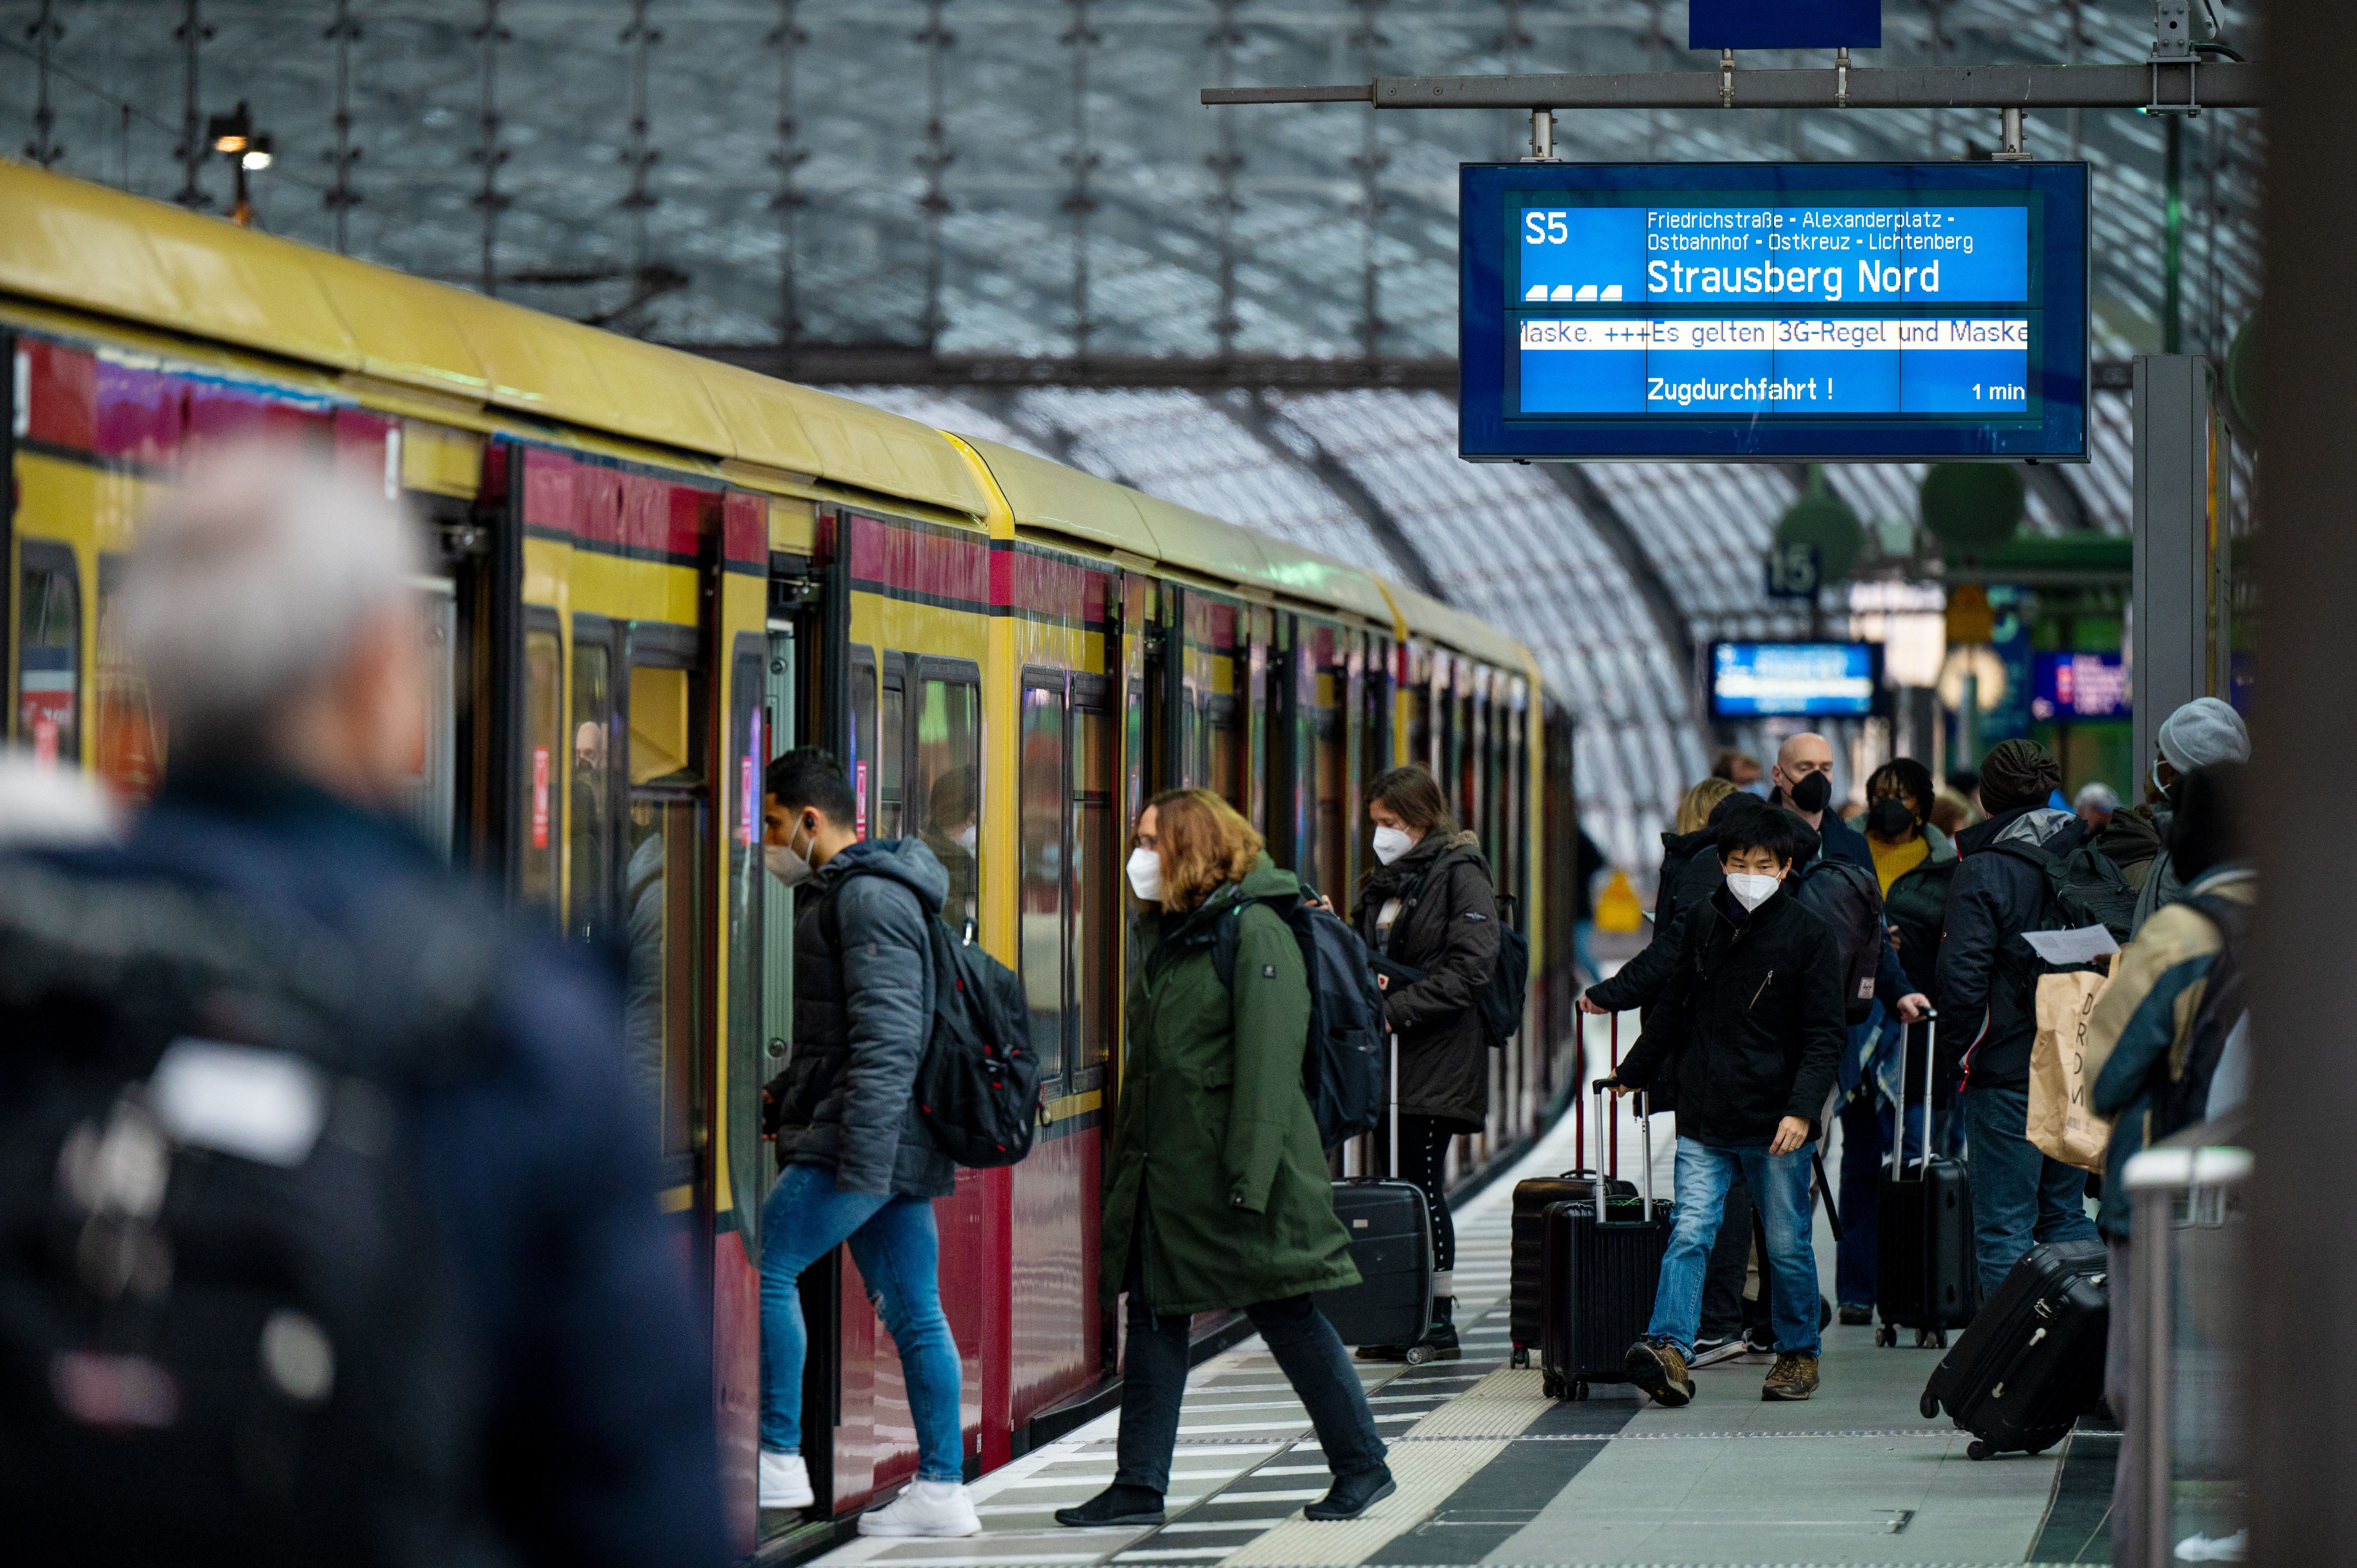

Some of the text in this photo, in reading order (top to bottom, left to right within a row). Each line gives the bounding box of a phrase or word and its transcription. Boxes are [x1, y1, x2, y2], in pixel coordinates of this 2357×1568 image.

[1526, 212, 1568, 244] S5
[1648, 211, 1783, 229] Friedrichstraße
[1803, 211, 1941, 232] Alexanderplatz
[1648, 234, 1749, 250] Ostbahnhof
[1769, 234, 1850, 250] Ostkreuz
[1869, 233, 1973, 254] Lichtenberg
[1648, 260, 1939, 301] Strausberg Nord
[1691, 321, 1765, 348] gelten
[1777, 321, 1886, 348] 3G-Regel
[1899, 321, 1938, 342] und
[1951, 321, 2027, 342] Maske
[1648, 377, 1832, 405] Zugdurchfahrt !
[1972, 383, 2025, 399] 1 min
